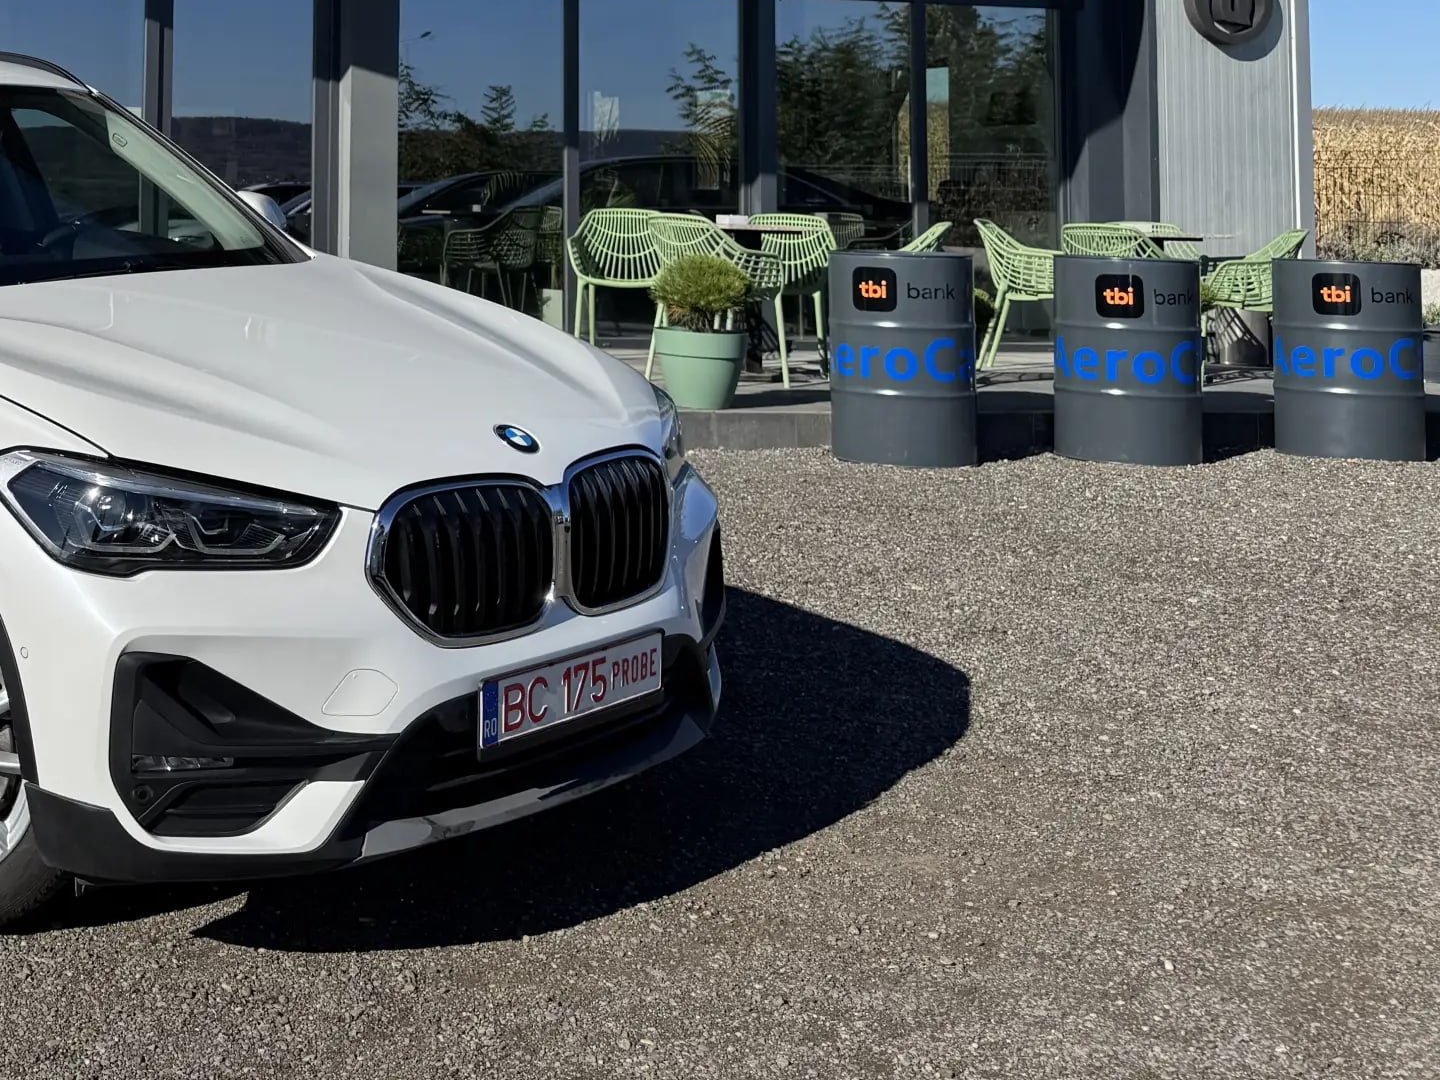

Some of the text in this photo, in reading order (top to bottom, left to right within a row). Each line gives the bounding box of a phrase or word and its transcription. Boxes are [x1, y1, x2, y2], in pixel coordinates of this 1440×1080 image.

[859, 280, 956, 300] tbi bank
[1103, 287, 1193, 306] tbi bank
[1320, 285, 1413, 304] tbi bank
[830, 337, 974, 383] eroCa
[1056, 335, 1197, 385] AeroC
[1274, 335, 1419, 381] AeroC
[502, 648, 657, 733] BC 175 PROBE
[484, 718, 497, 739] RO
